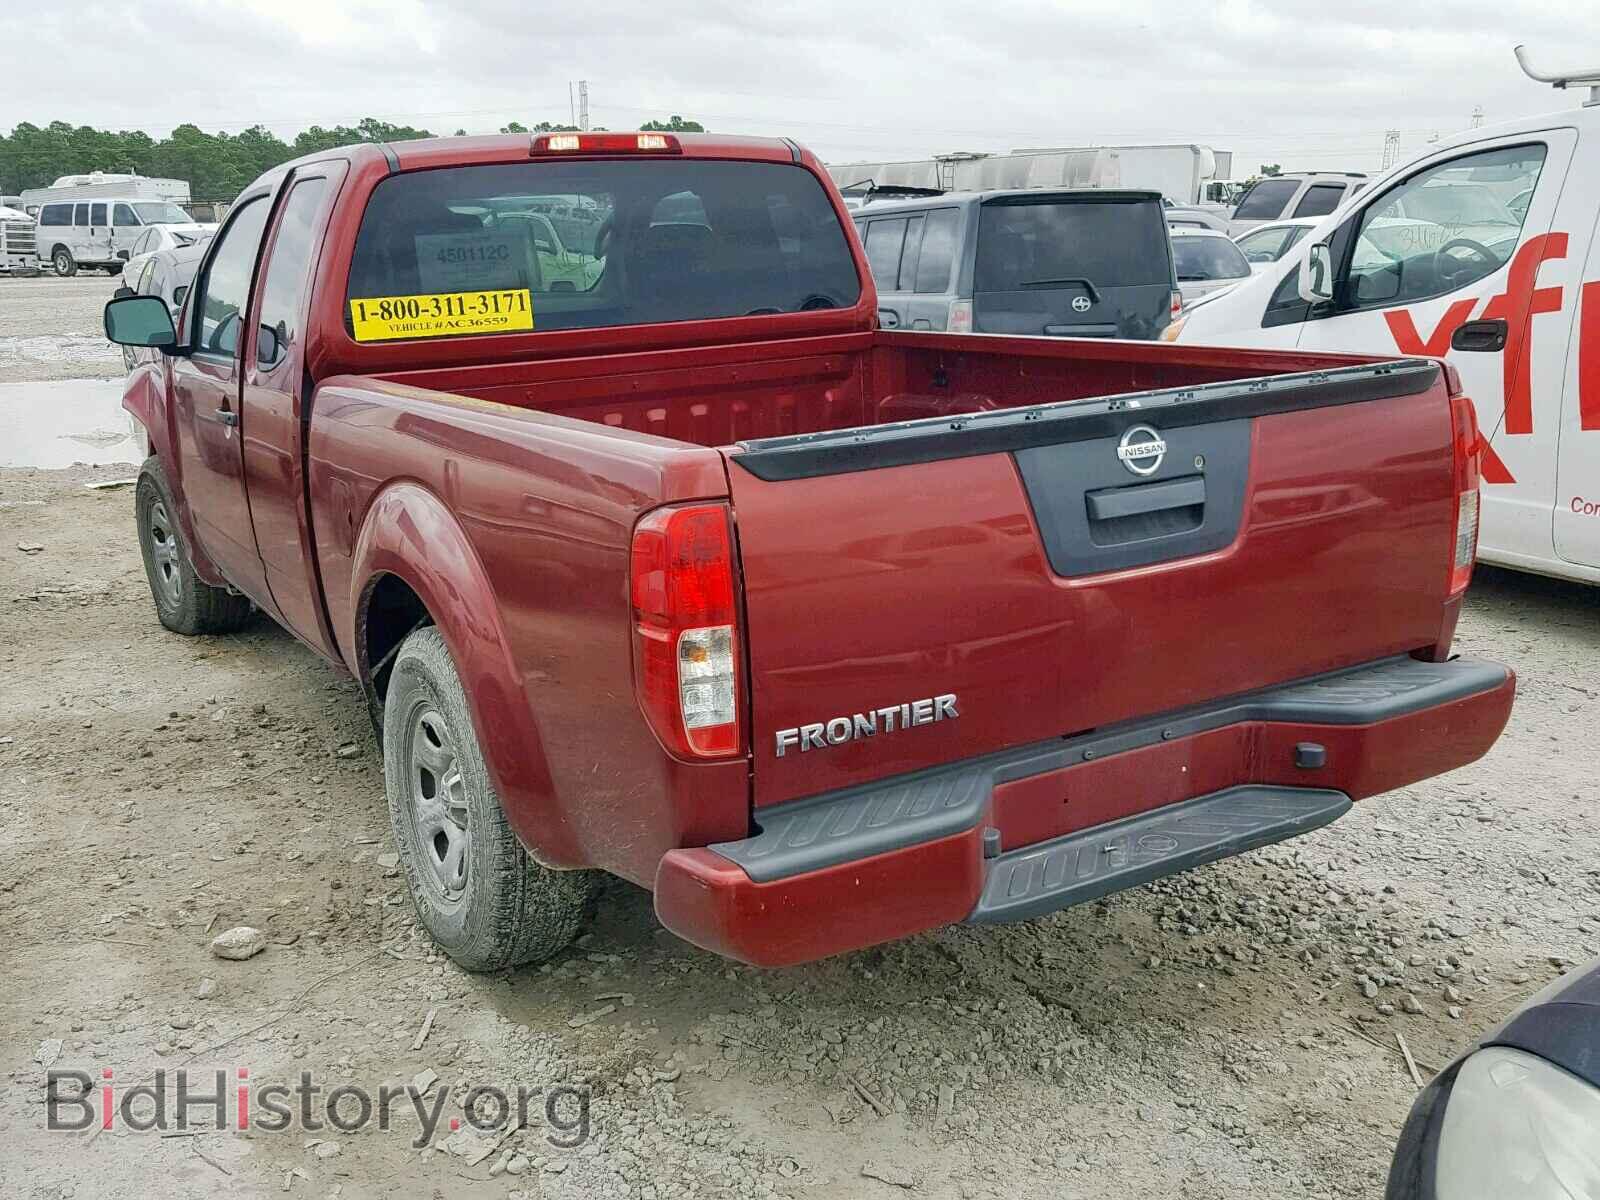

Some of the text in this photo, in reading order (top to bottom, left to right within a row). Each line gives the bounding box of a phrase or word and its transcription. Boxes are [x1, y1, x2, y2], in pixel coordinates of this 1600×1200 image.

[437, 244, 510, 264] 450112C
[357, 291, 528, 323] 1-800-311-3171
[389, 321, 433, 332] VEHICLE
[1124, 444, 1164, 457] NISSAN
[775, 693, 960, 758] FRONTIER
